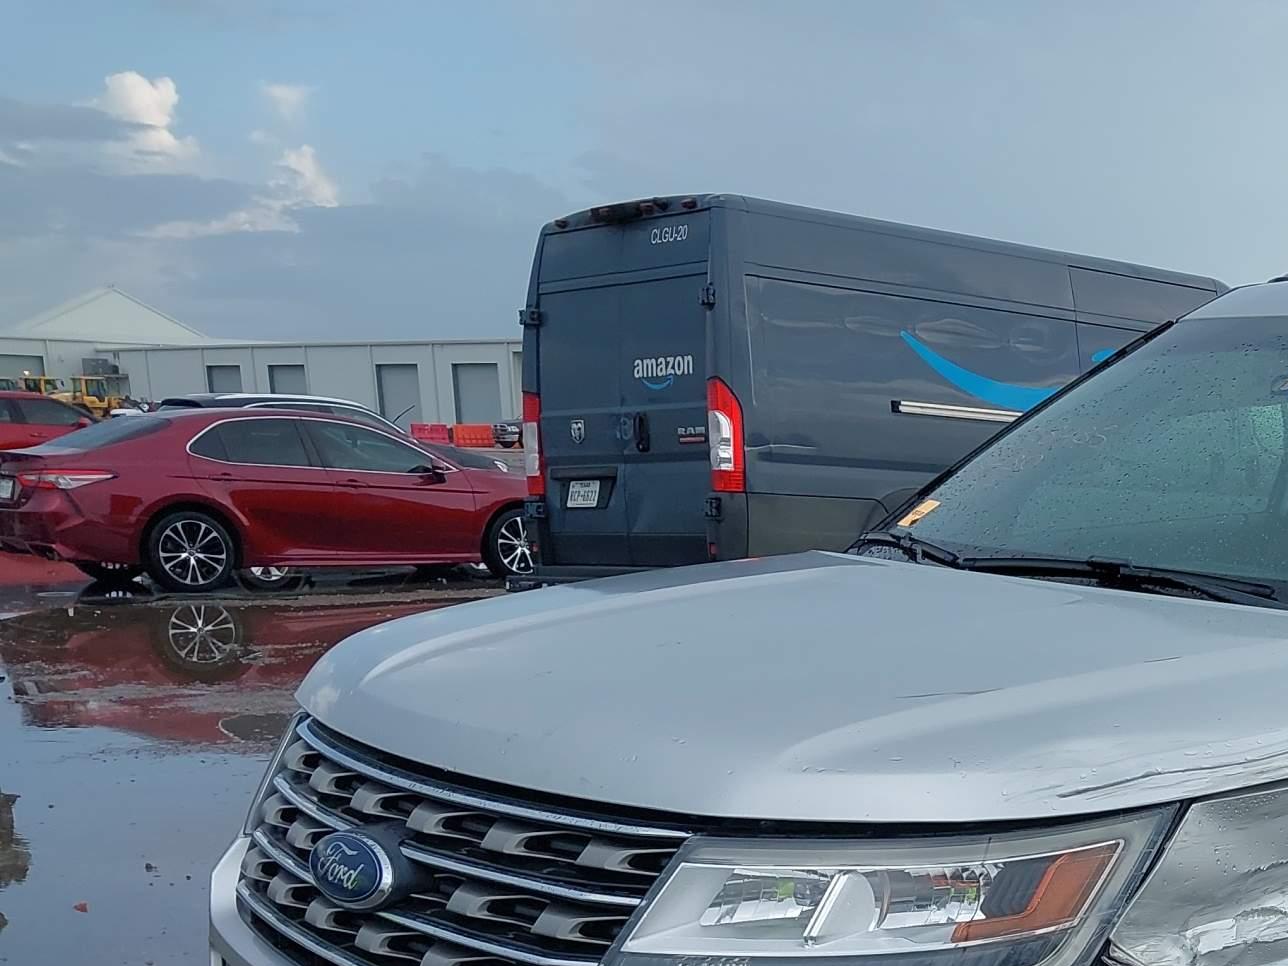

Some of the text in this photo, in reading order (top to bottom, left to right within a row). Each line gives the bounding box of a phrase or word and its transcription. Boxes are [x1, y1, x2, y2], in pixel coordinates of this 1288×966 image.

[651, 224, 688, 244] CLGU-20
[634, 355, 693, 378] amazon
[677, 426, 706, 435] RAM
[318, 841, 365, 889] Ford
